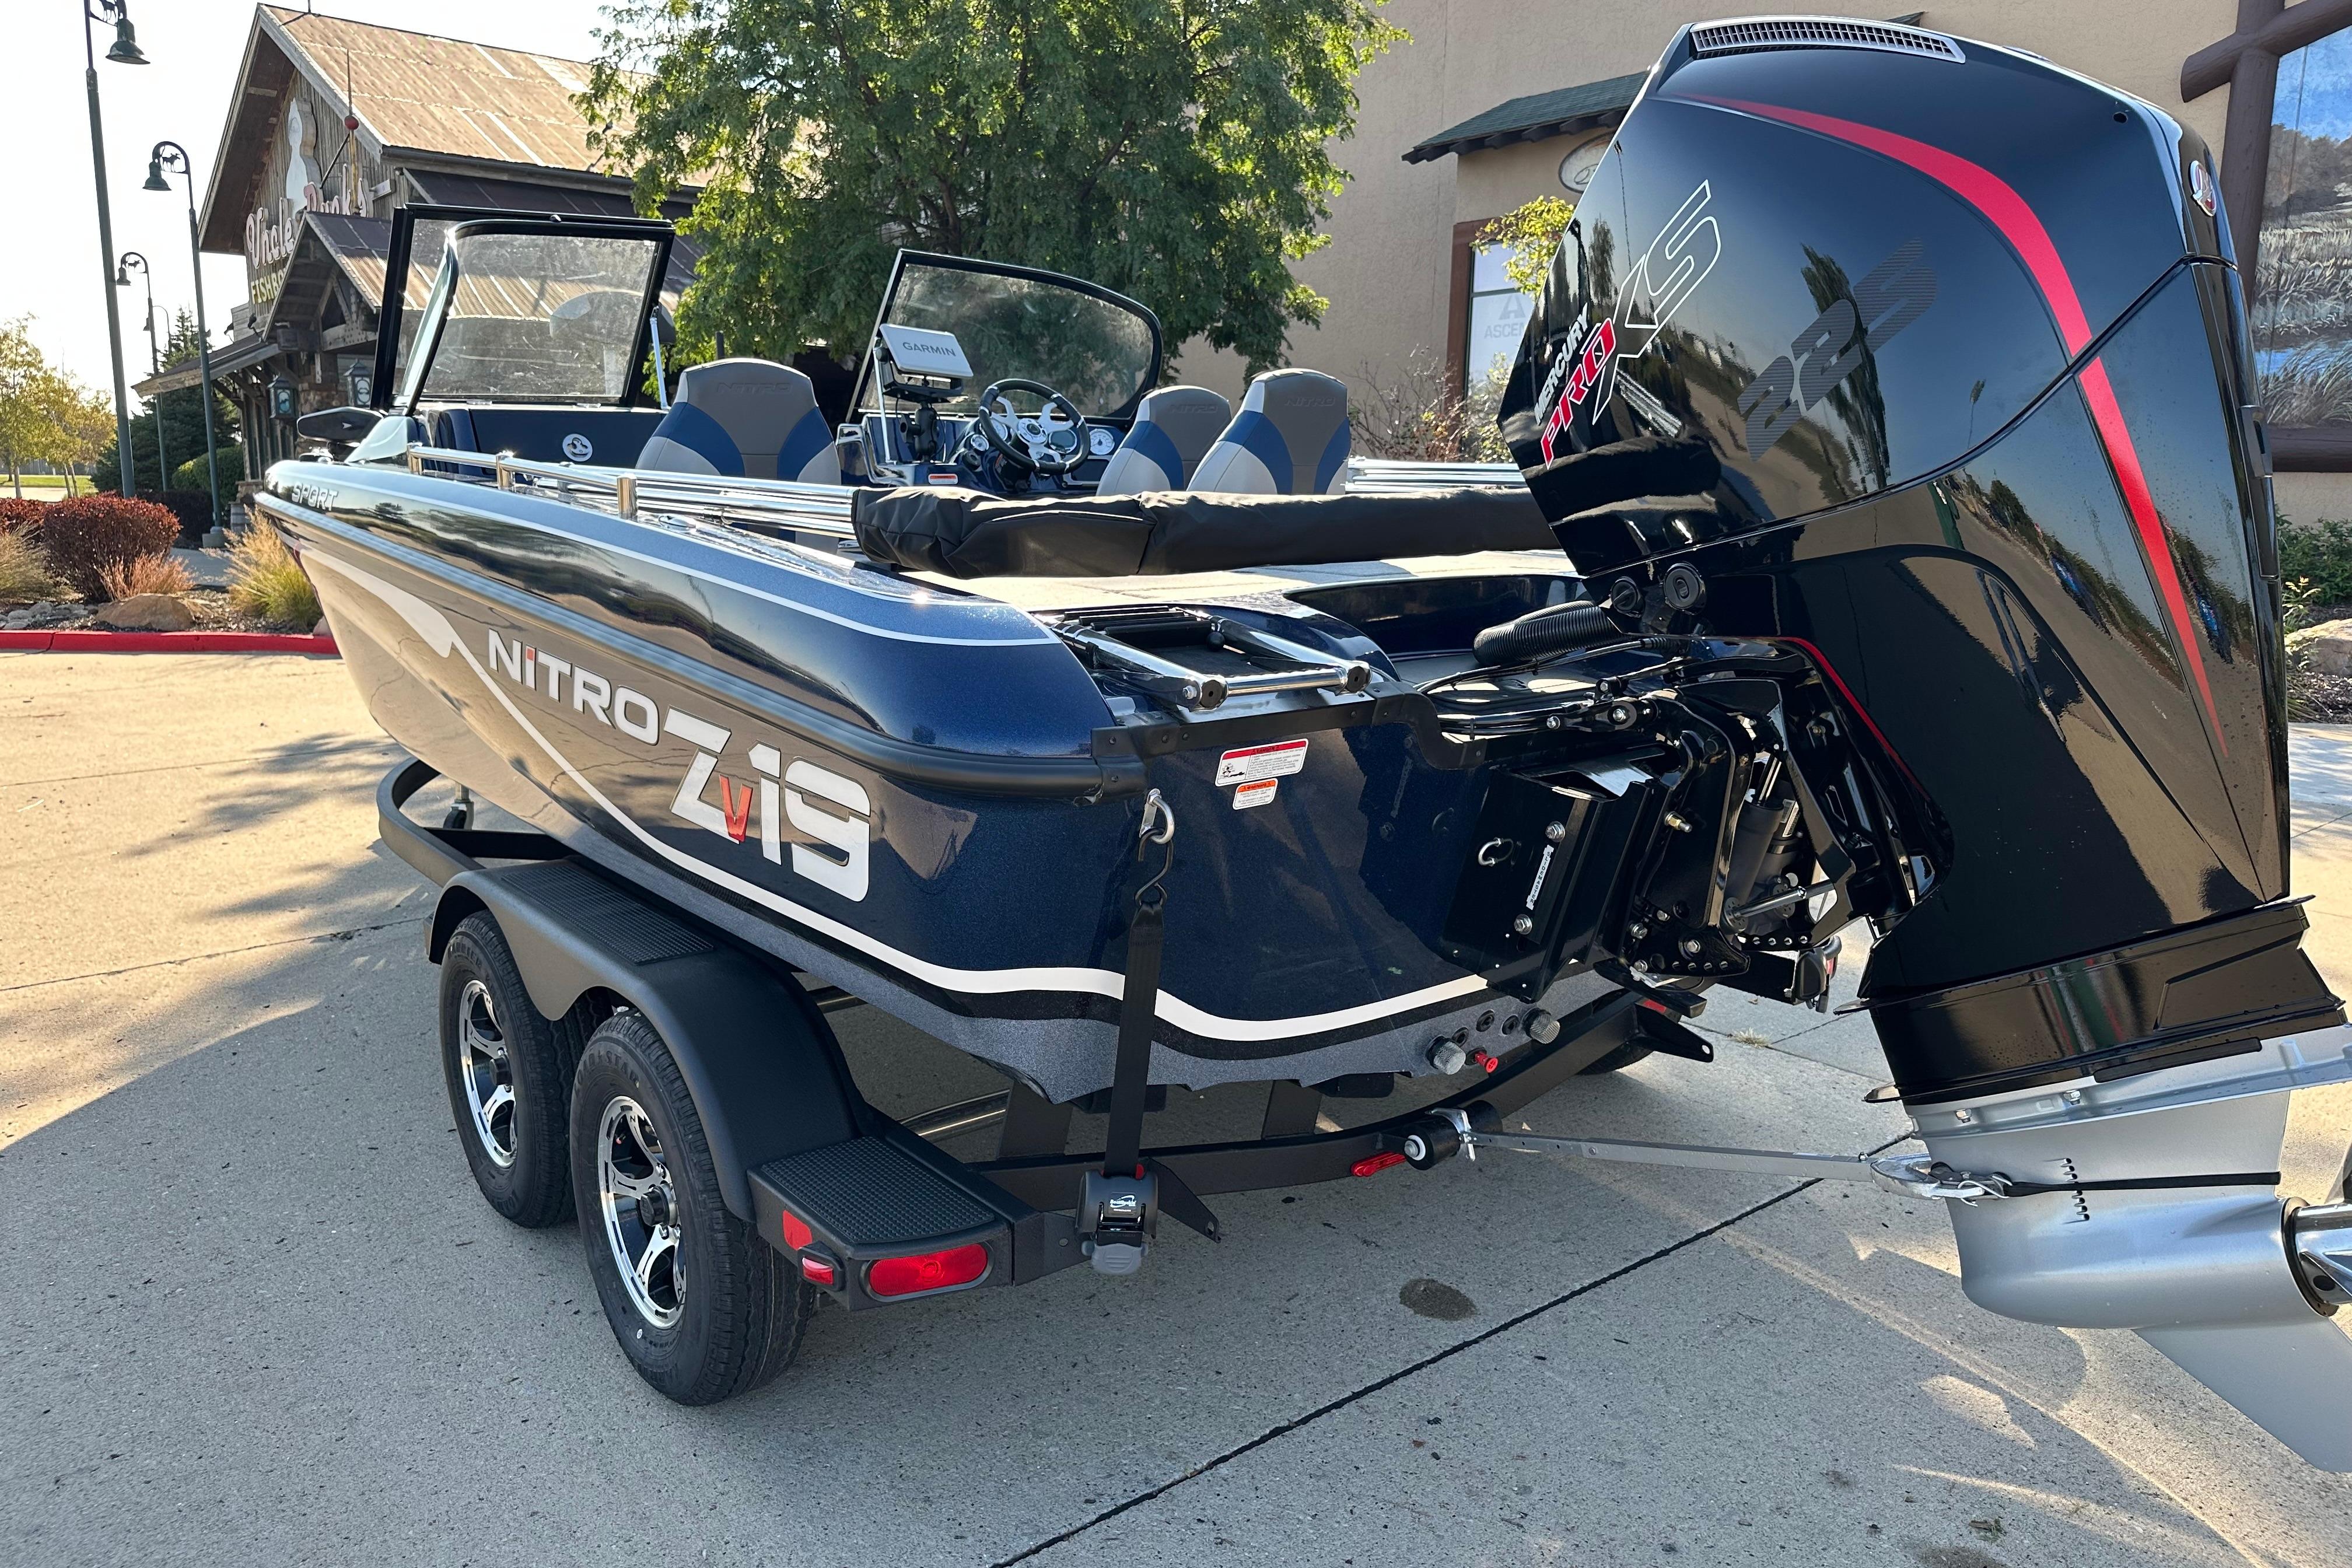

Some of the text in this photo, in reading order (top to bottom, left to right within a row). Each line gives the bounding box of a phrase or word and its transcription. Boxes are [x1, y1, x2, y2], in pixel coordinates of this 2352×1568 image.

[246, 197, 294, 270] Uncle
[251, 268, 286, 304] FISHBO
[1484, 323, 1526, 338] ASCEN
[902, 342, 956, 356] GARMIN
[1534, 302, 1588, 425] MERCURY
[716, 382, 793, 395] NITRO
[1284, 396, 1336, 407] NITRO
[1541, 317, 1616, 470] PRO
[1170, 404, 1218, 414] NITRO
[292, 481, 338, 512] SPORT
[1530, 851, 1550, 904] SLIDEMASTER
